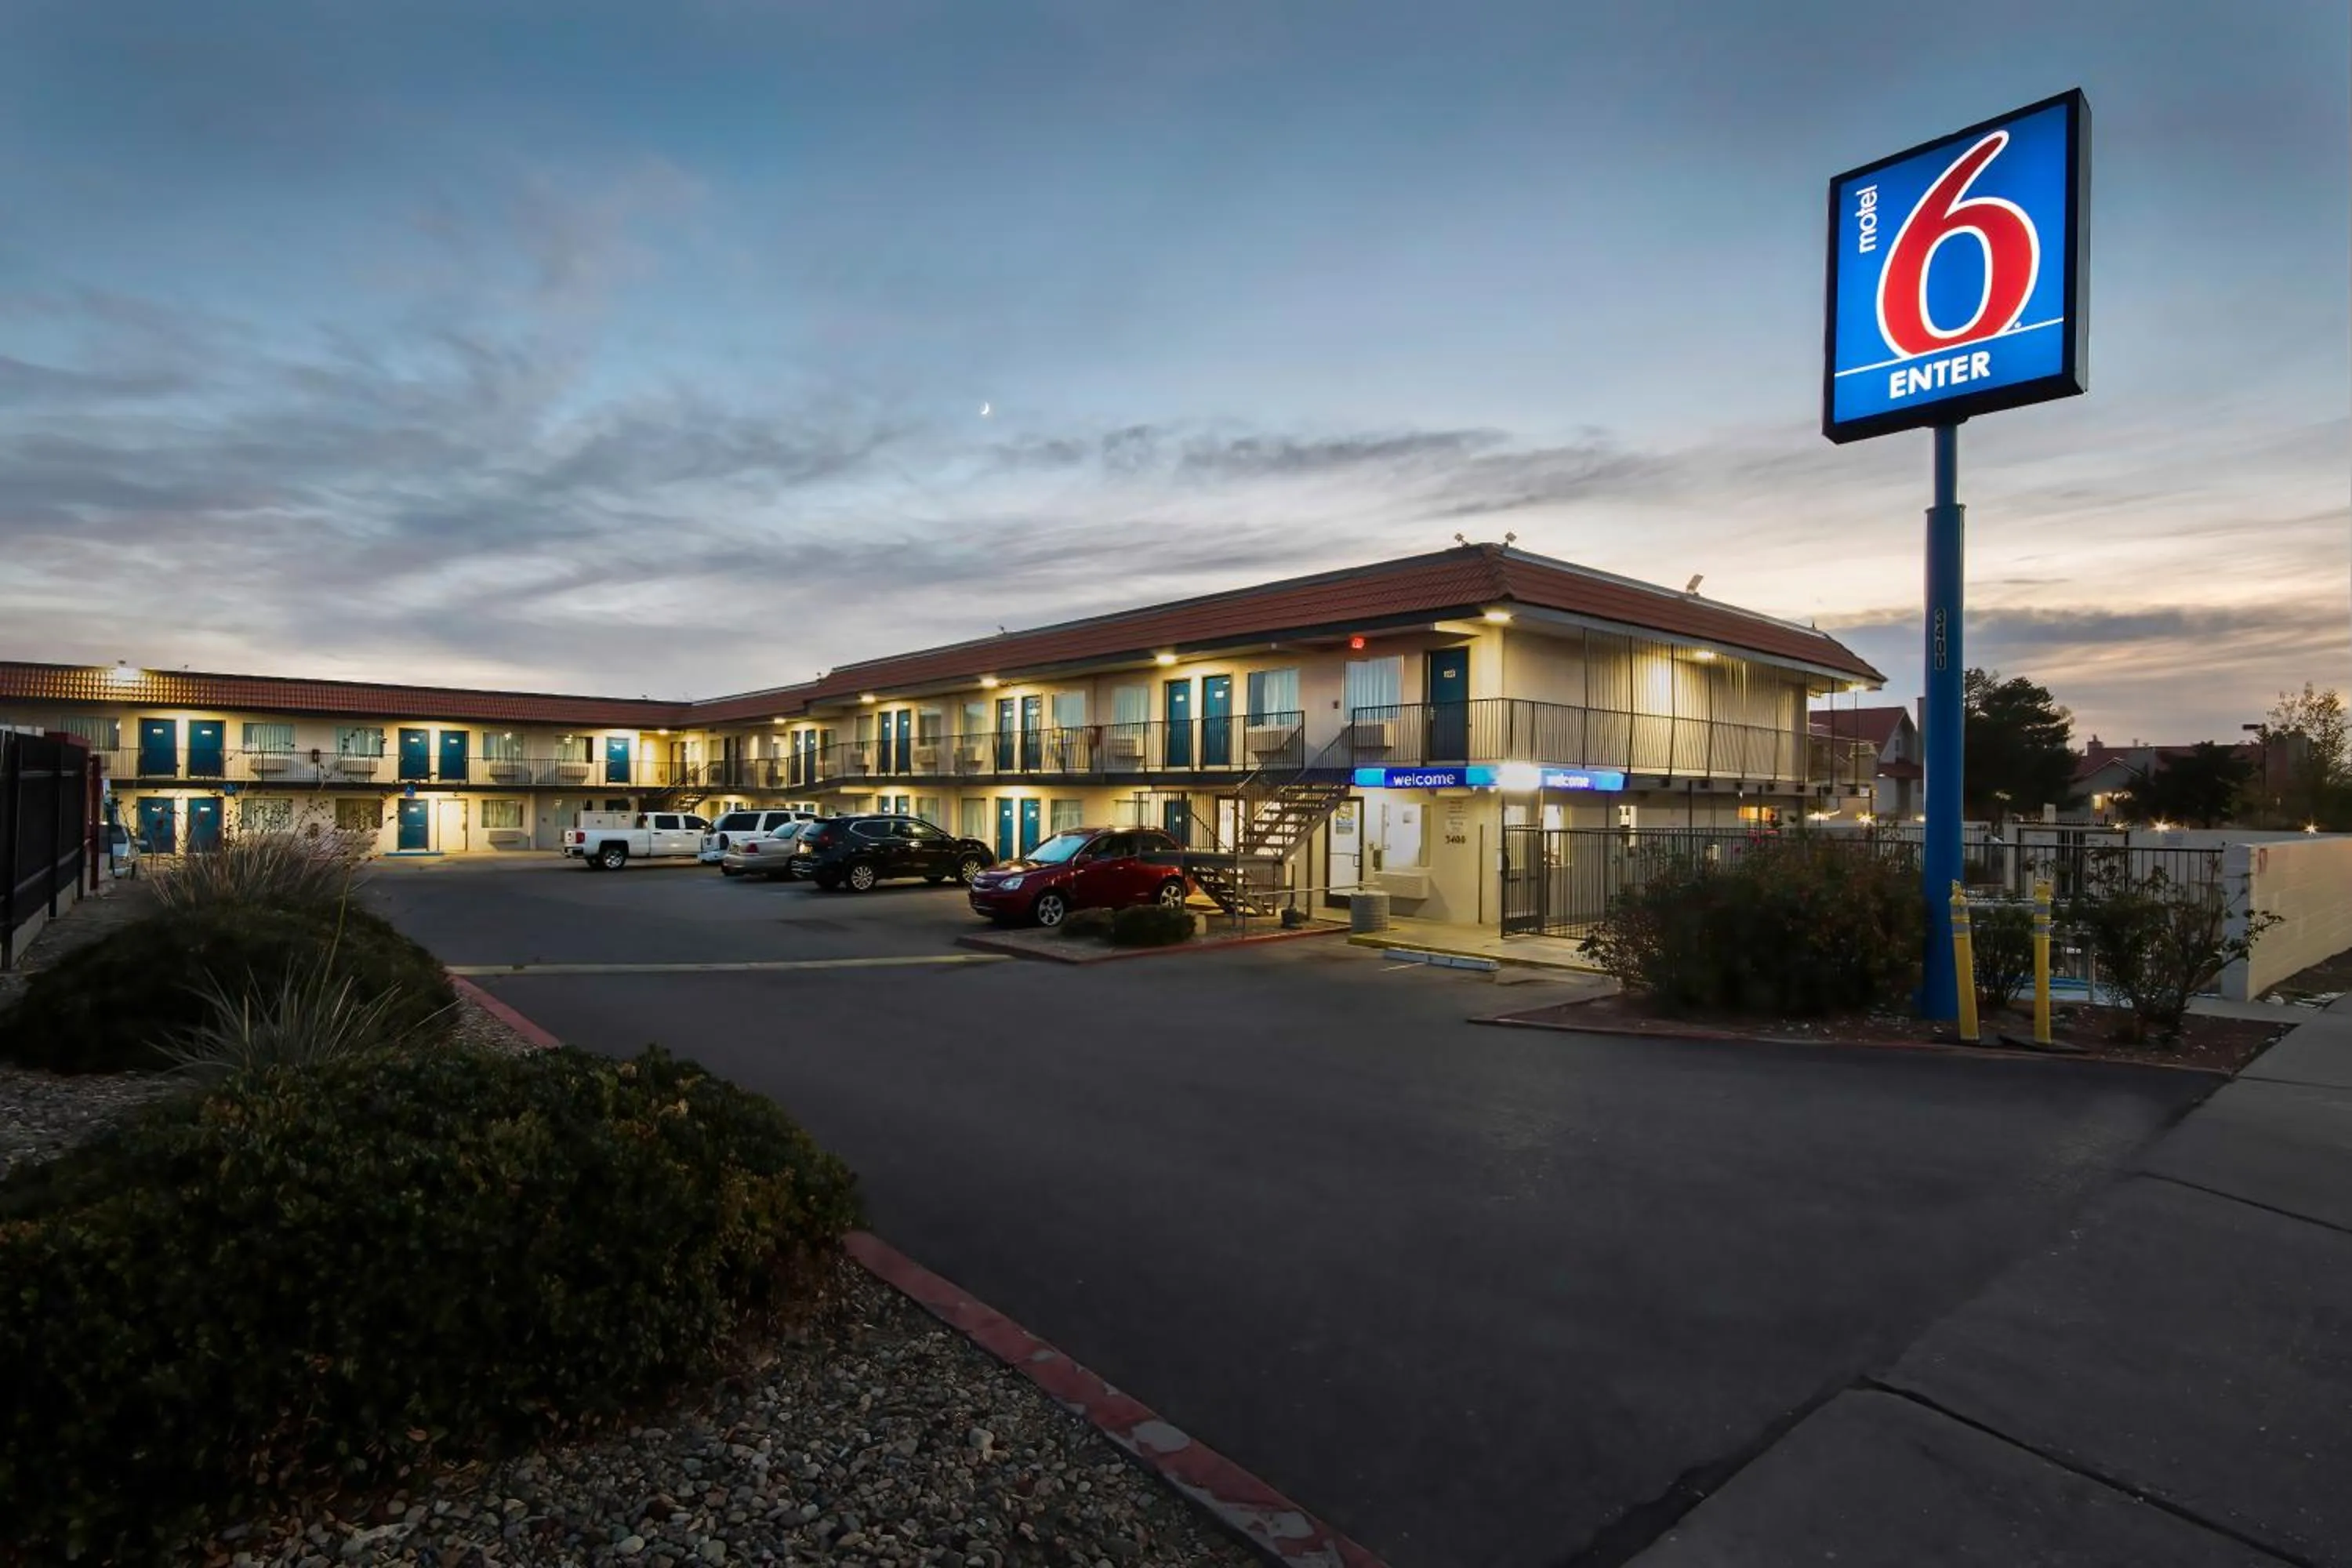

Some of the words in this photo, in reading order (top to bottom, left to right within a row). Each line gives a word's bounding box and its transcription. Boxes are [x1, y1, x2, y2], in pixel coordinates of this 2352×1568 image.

[1856, 184, 1878, 253] motel
[1876, 130, 2040, 358] 6
[1889, 351, 1990, 398] ENTER
[1393, 772, 1456, 786] welcome
